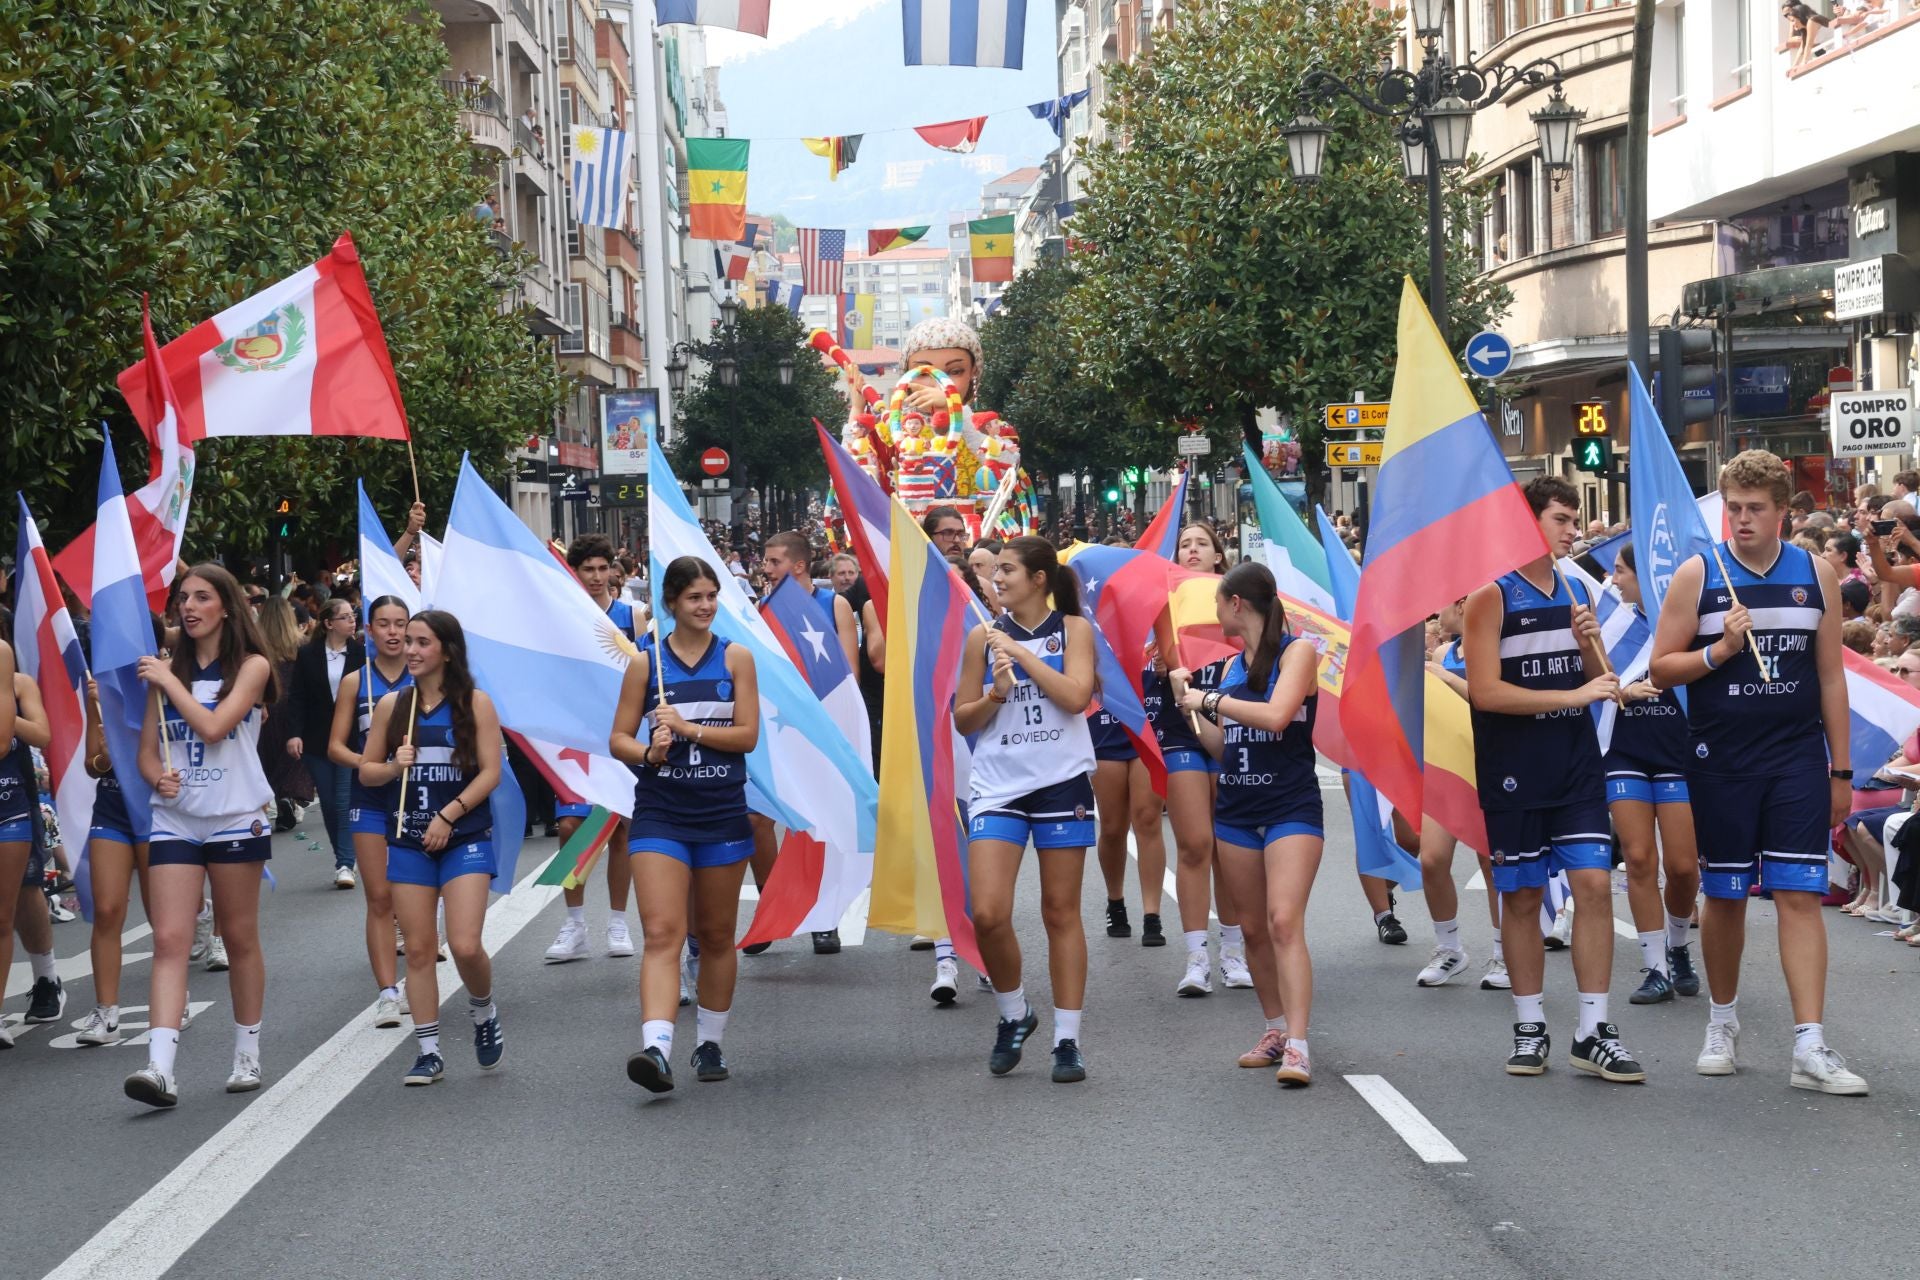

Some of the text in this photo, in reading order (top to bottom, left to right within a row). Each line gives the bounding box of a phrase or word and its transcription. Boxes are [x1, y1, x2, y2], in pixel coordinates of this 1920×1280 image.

[1837, 264, 1882, 293] COMPRO ORO
[1840, 398, 1907, 414] COMPRO
[1361, 410, 1369, 419] El
[1371, 410, 1389, 419] Cort
[1580, 405, 1606, 433] 26
[1850, 416, 1901, 439] ORO
[1865, 441, 1906, 450] INMEDIATO
[1365, 454, 1381, 462] Rec
[1248, 532, 1264, 542] SOR
[1200, 665, 1216, 685] 17
[1521, 659, 1545, 678] C.D.
[1743, 681, 1796, 696] OVIEDO
[1023, 704, 1043, 726] 13
[1633, 705, 1677, 716] OVIEDO
[1011, 729, 1060, 745] OVIEDO
[186, 741, 205, 767] 13
[689, 743, 702, 766] 6
[1180, 752, 1190, 763] 17
[1238, 747, 1250, 773] 3
[672, 765, 728, 779] OVIEDO
[1226, 773, 1273, 786] OVIEDO
[1616, 782, 1626, 794] 11
[417, 786, 429, 810] 3
[412, 810, 430, 820] San
[973, 817, 985, 833] 13
[1731, 876, 1742, 891] 91
